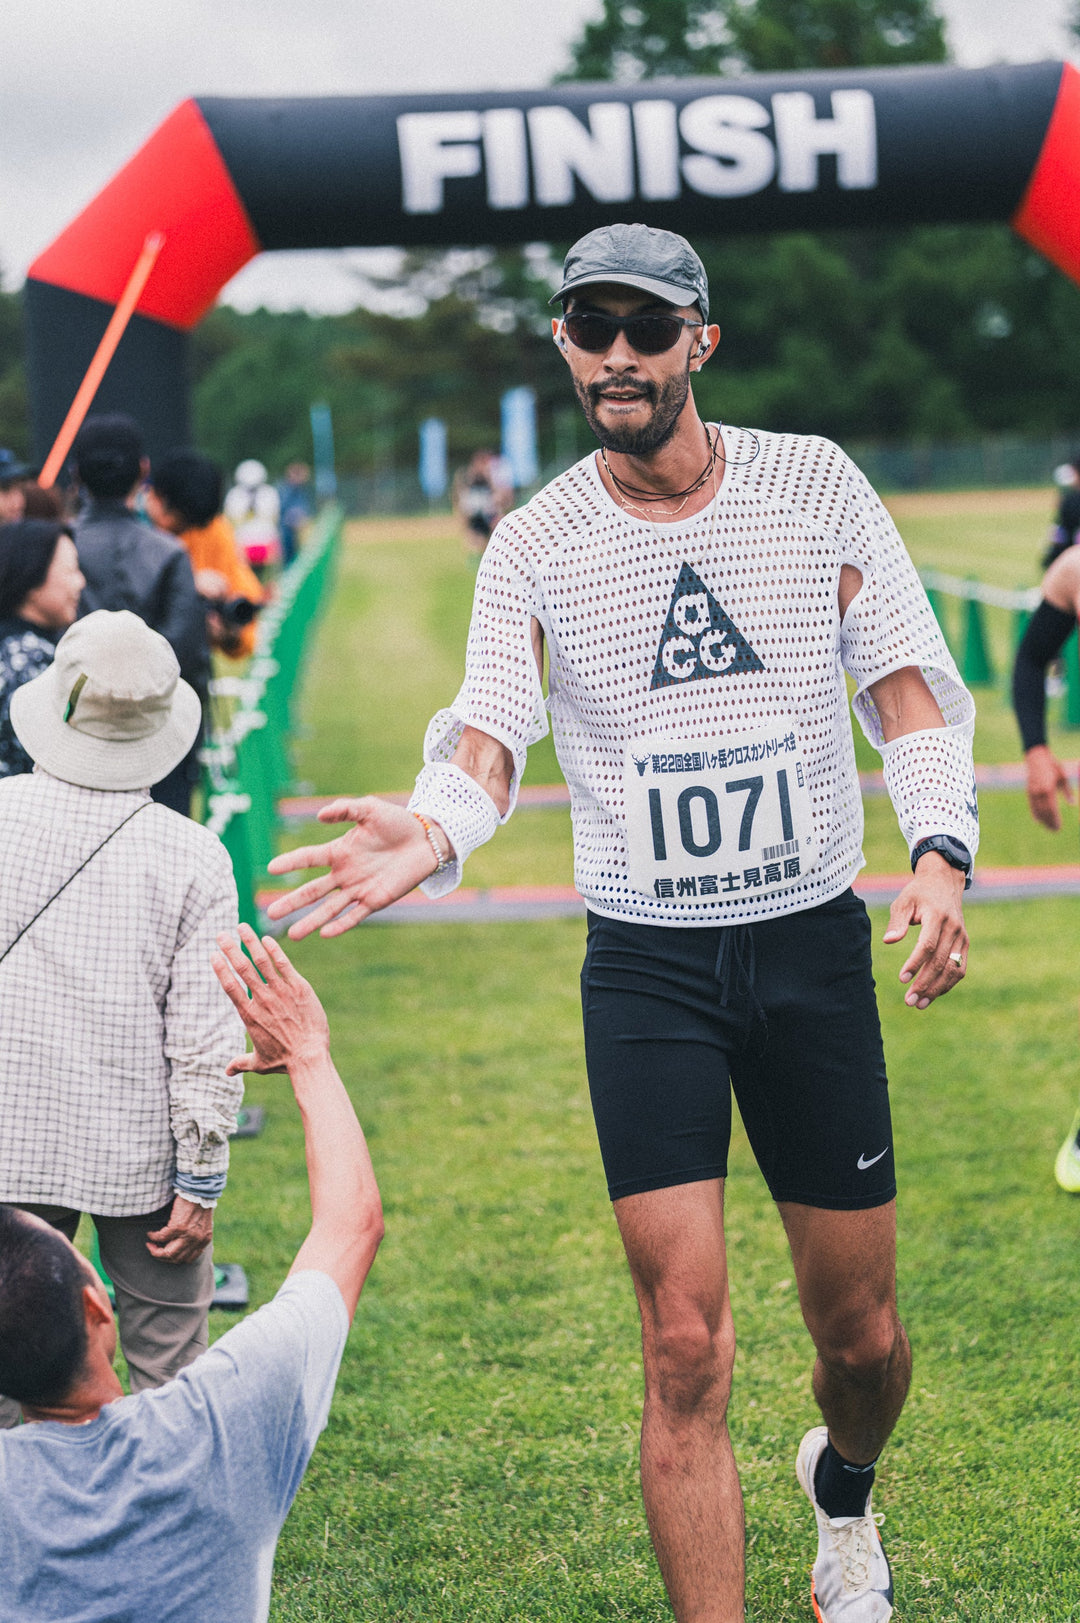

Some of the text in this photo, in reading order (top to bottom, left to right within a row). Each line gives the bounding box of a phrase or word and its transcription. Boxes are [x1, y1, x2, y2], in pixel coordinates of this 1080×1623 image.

[396, 89, 878, 214] FINISH
[648, 769, 794, 861] 1071
[653, 857, 801, 899] 信州富士見高原
